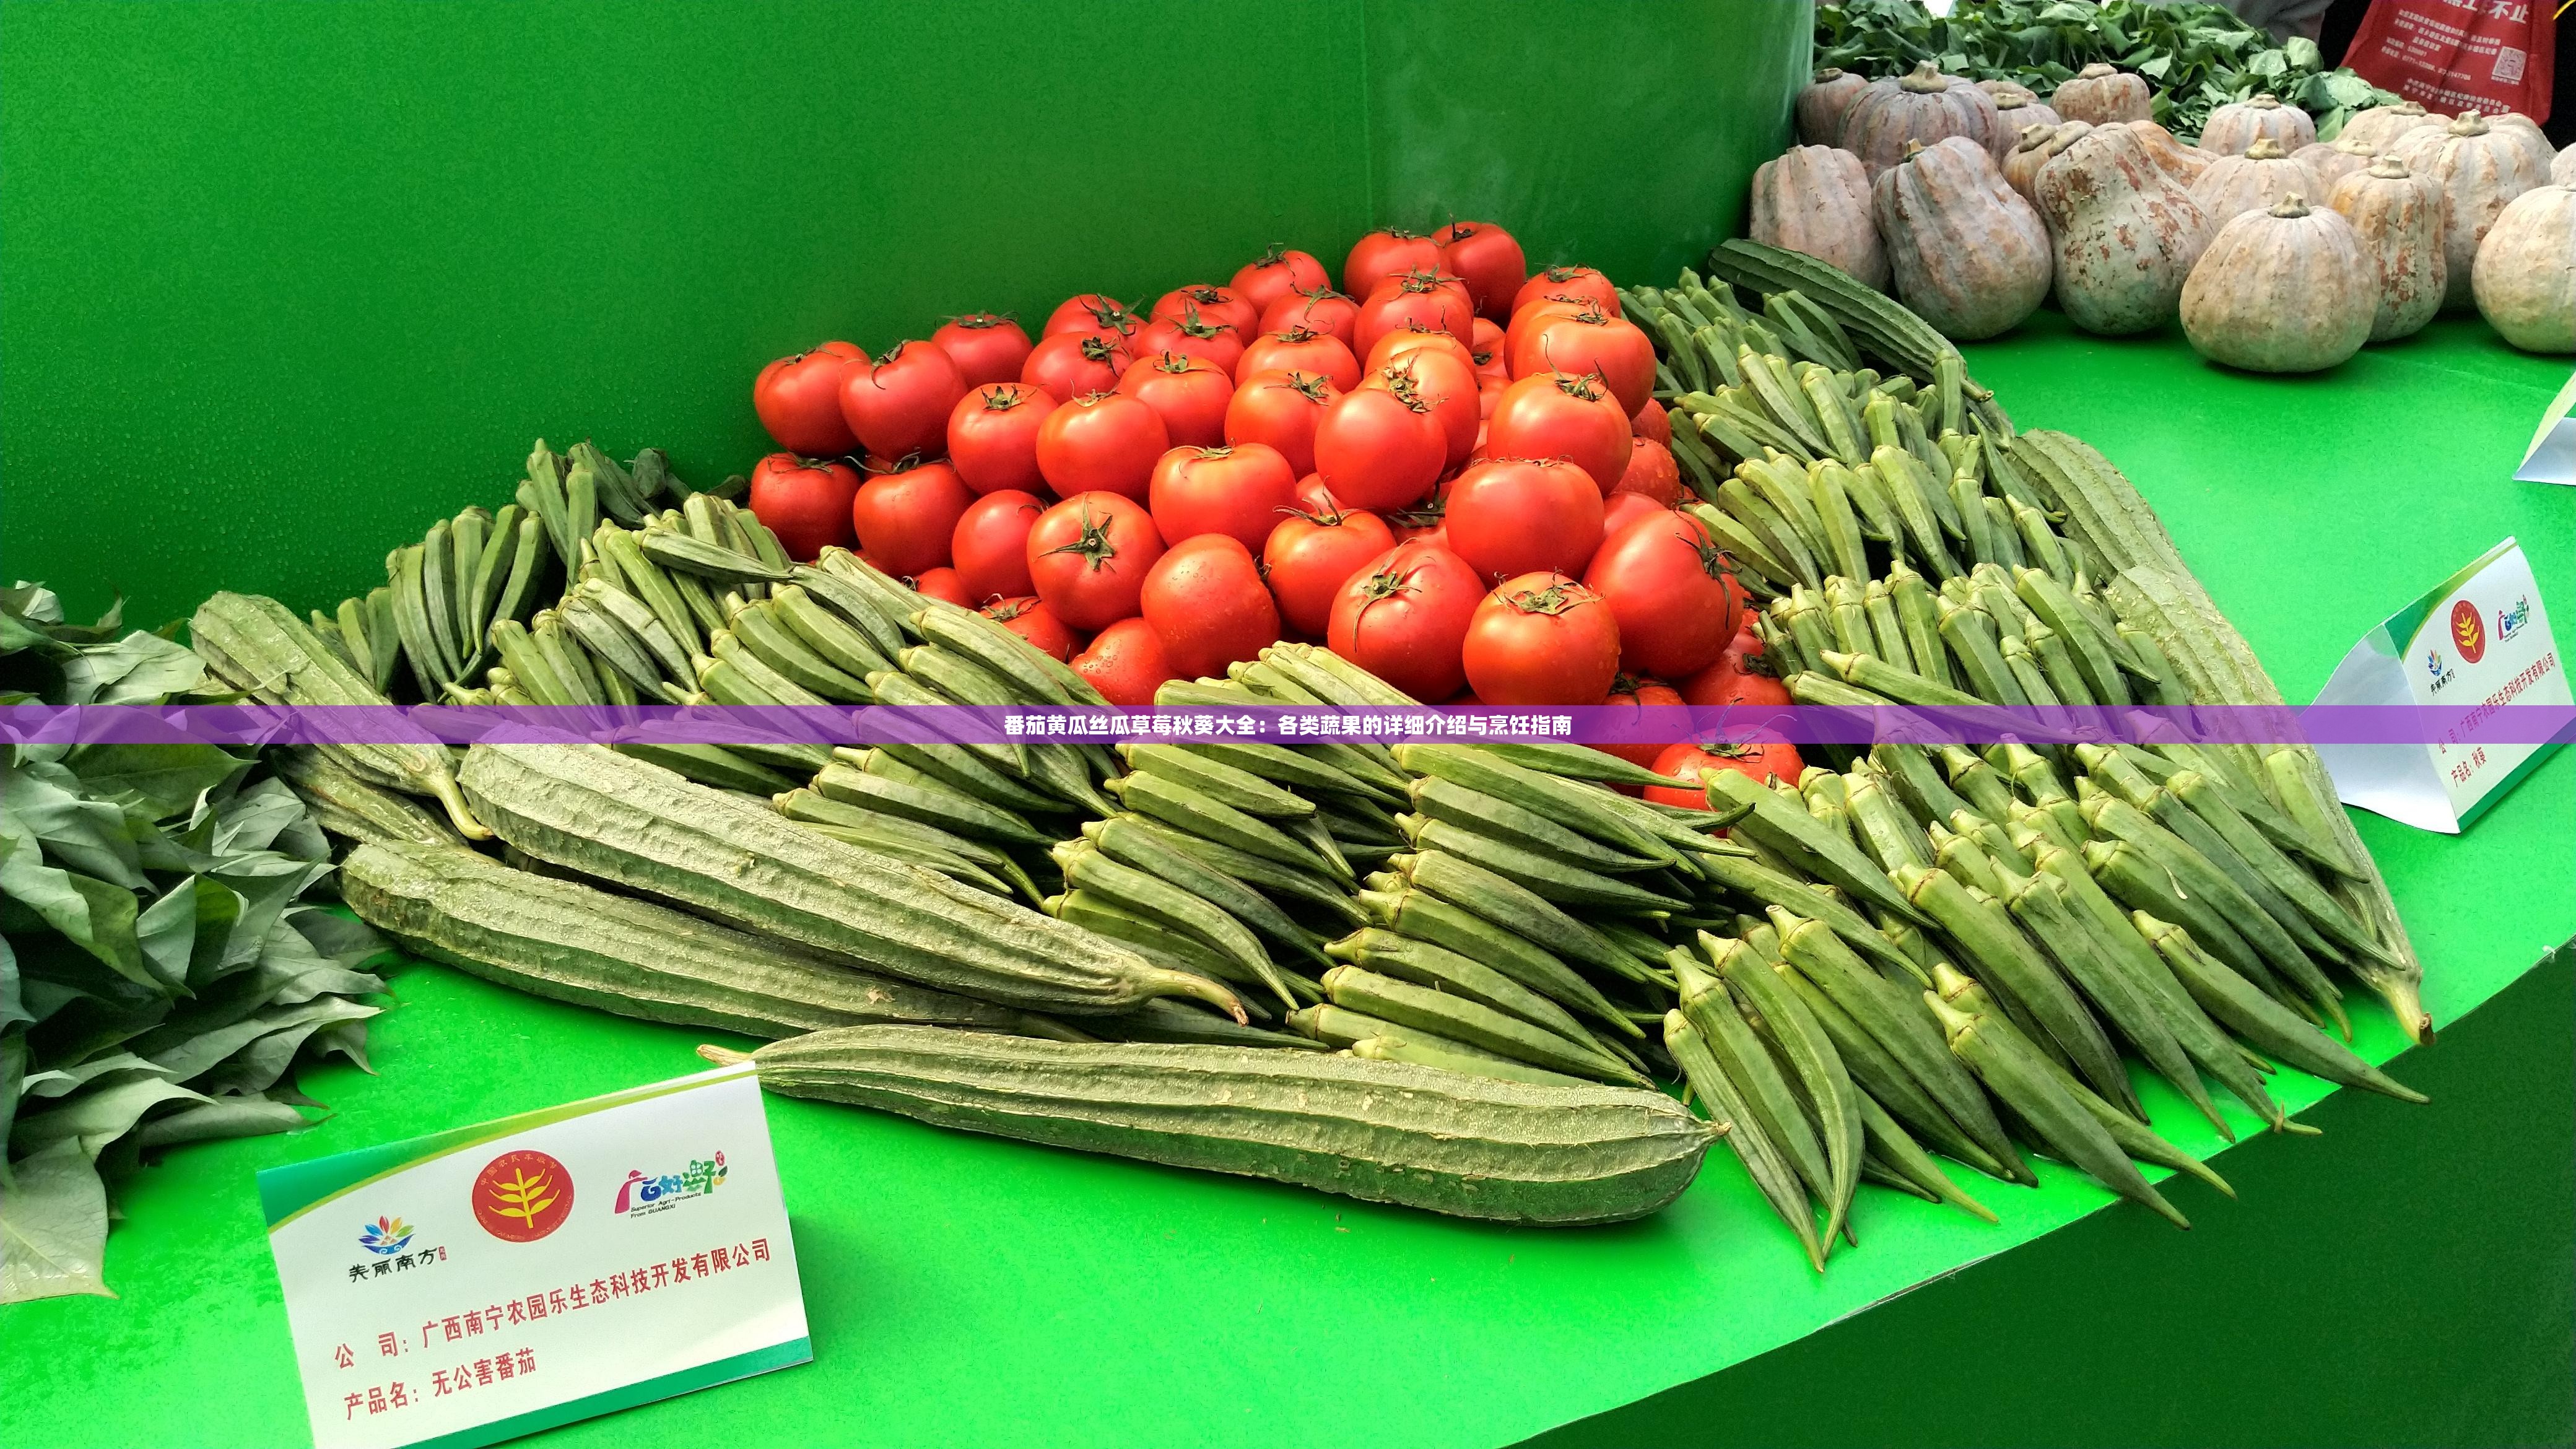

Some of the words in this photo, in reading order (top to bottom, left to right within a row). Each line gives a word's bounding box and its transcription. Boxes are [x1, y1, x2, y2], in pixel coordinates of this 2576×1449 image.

[630, 1203, 655, 1212] Superior
[648, 1204, 676, 1214] GUANGXI
[349, 1248, 437, 1282] 美丽南方
